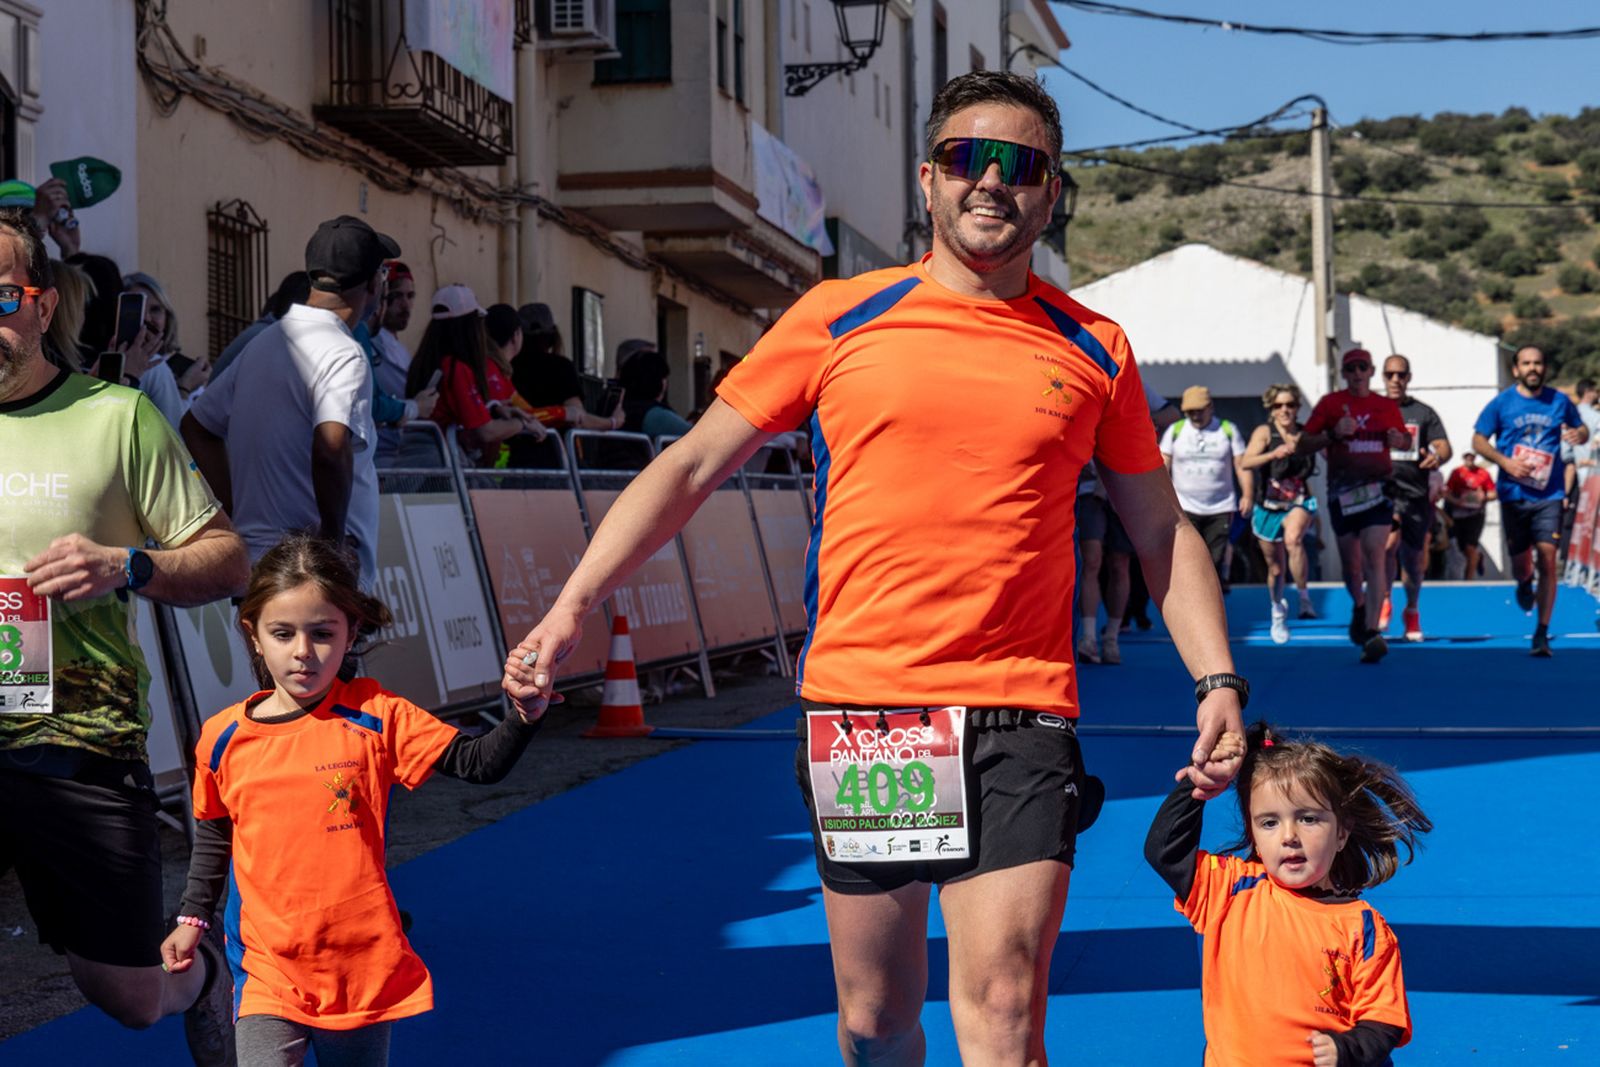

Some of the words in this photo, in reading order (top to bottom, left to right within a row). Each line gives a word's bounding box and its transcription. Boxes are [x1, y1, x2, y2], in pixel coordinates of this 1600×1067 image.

[856, 726, 935, 748] CROSS
[328, 759, 359, 770] LEGIÓN
[830, 747, 915, 767] PANTANO
[836, 761, 934, 815] 409
[824, 819, 857, 830] ISIDRO
